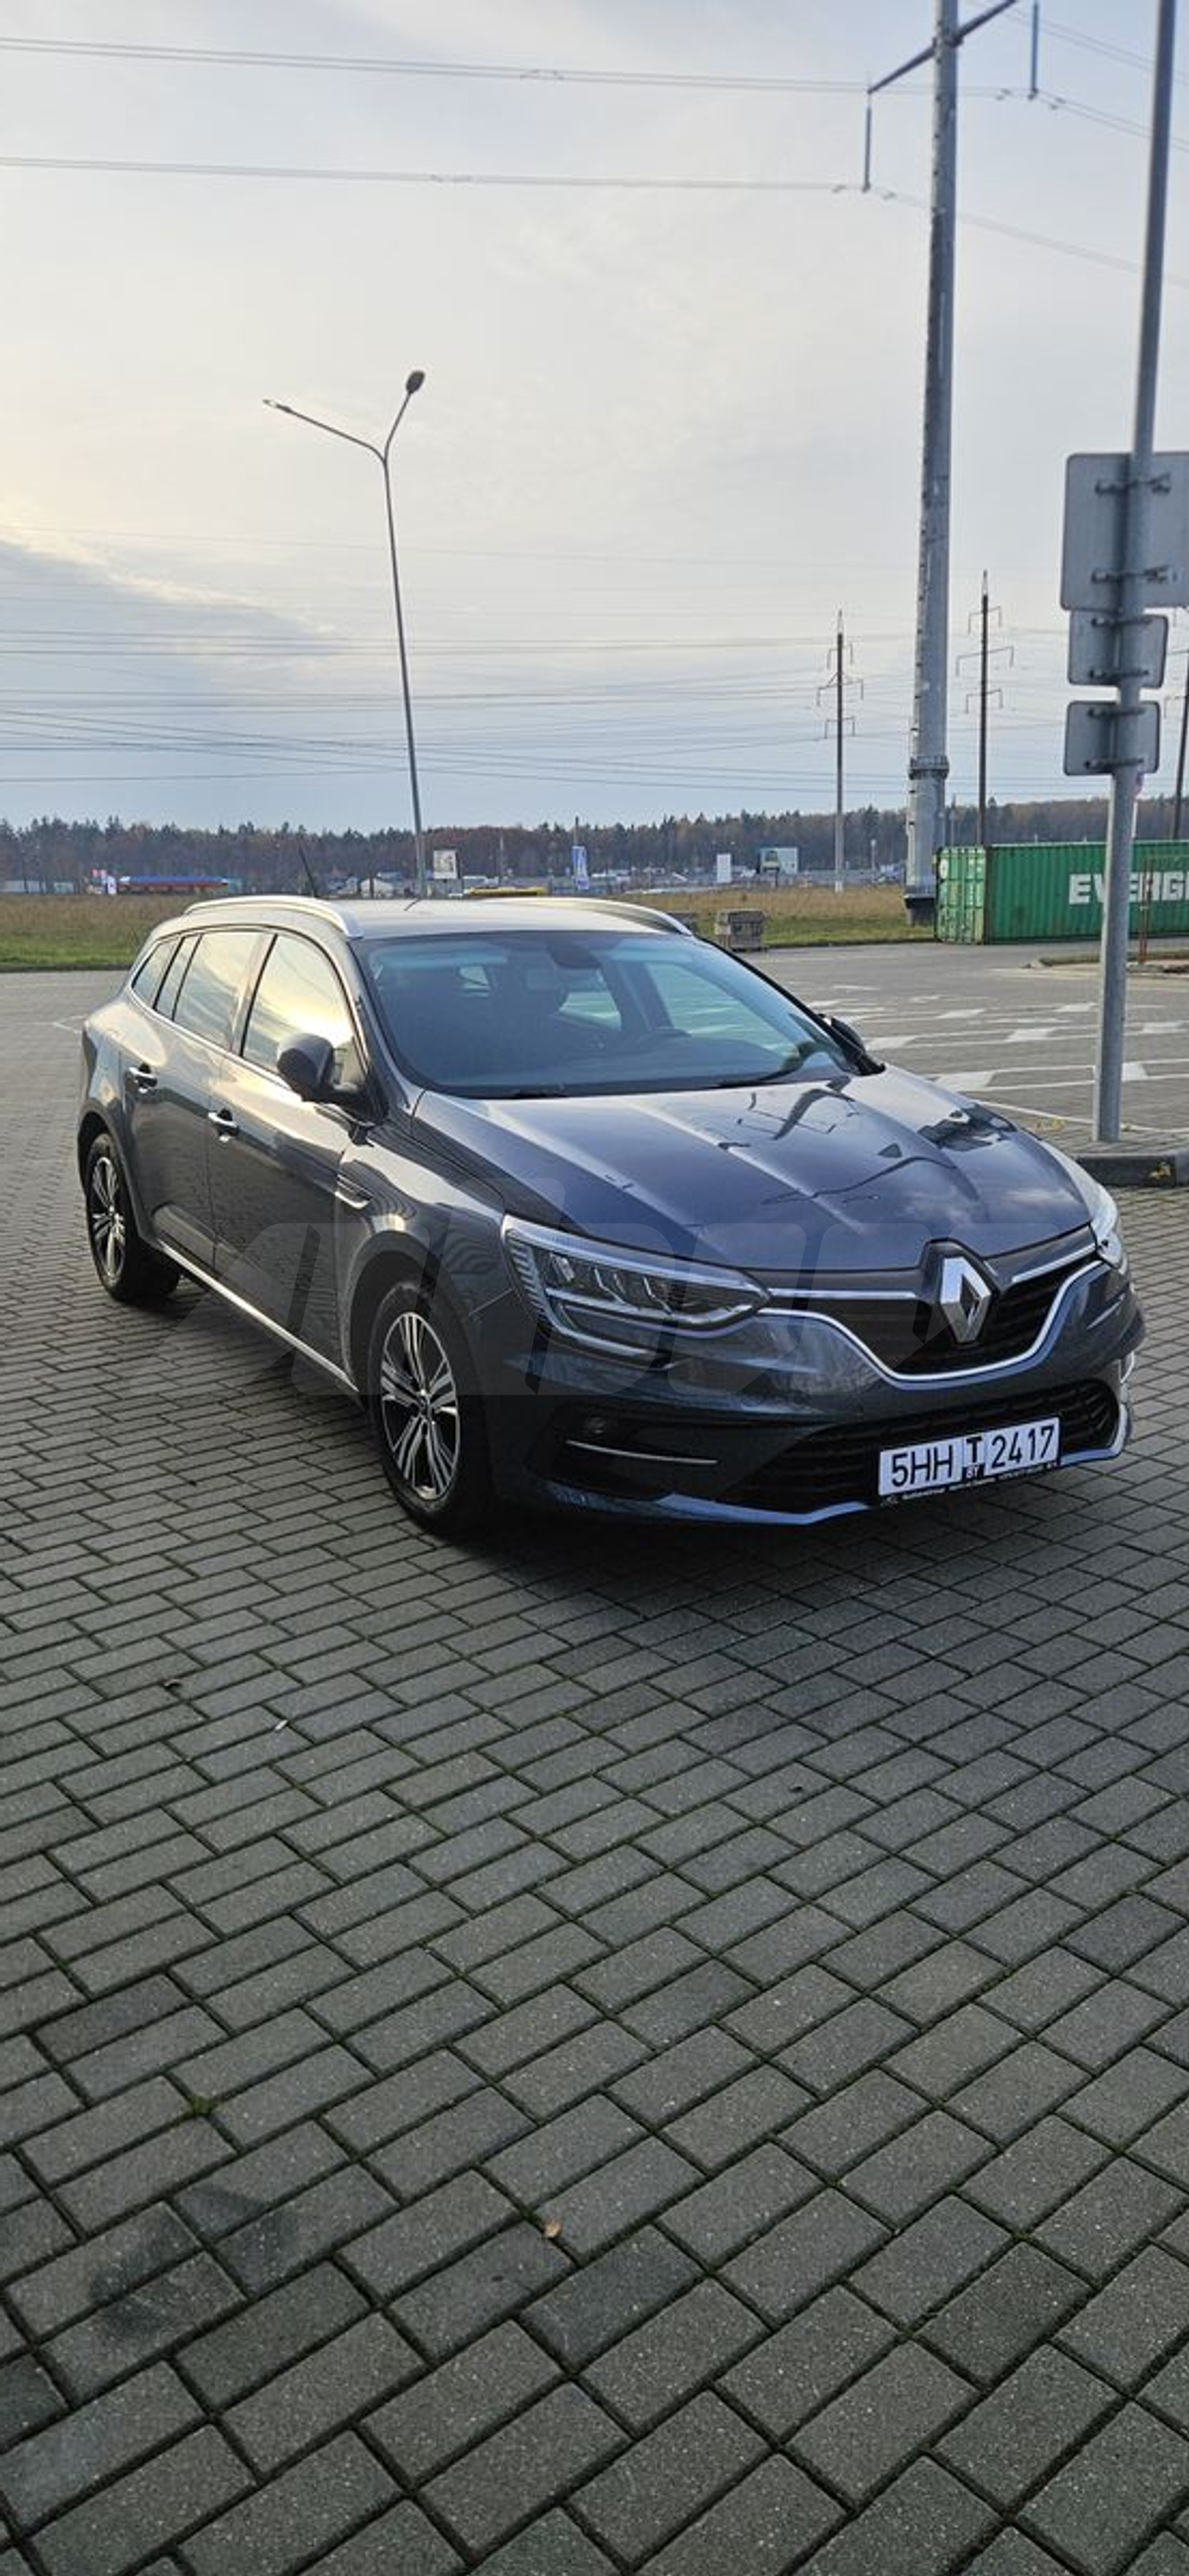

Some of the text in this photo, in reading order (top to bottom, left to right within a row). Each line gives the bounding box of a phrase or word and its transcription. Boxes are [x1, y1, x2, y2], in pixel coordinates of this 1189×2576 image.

[1069, 871, 1189, 905] EVRG
[892, 1425, 1054, 1487] 5HH T 2417
